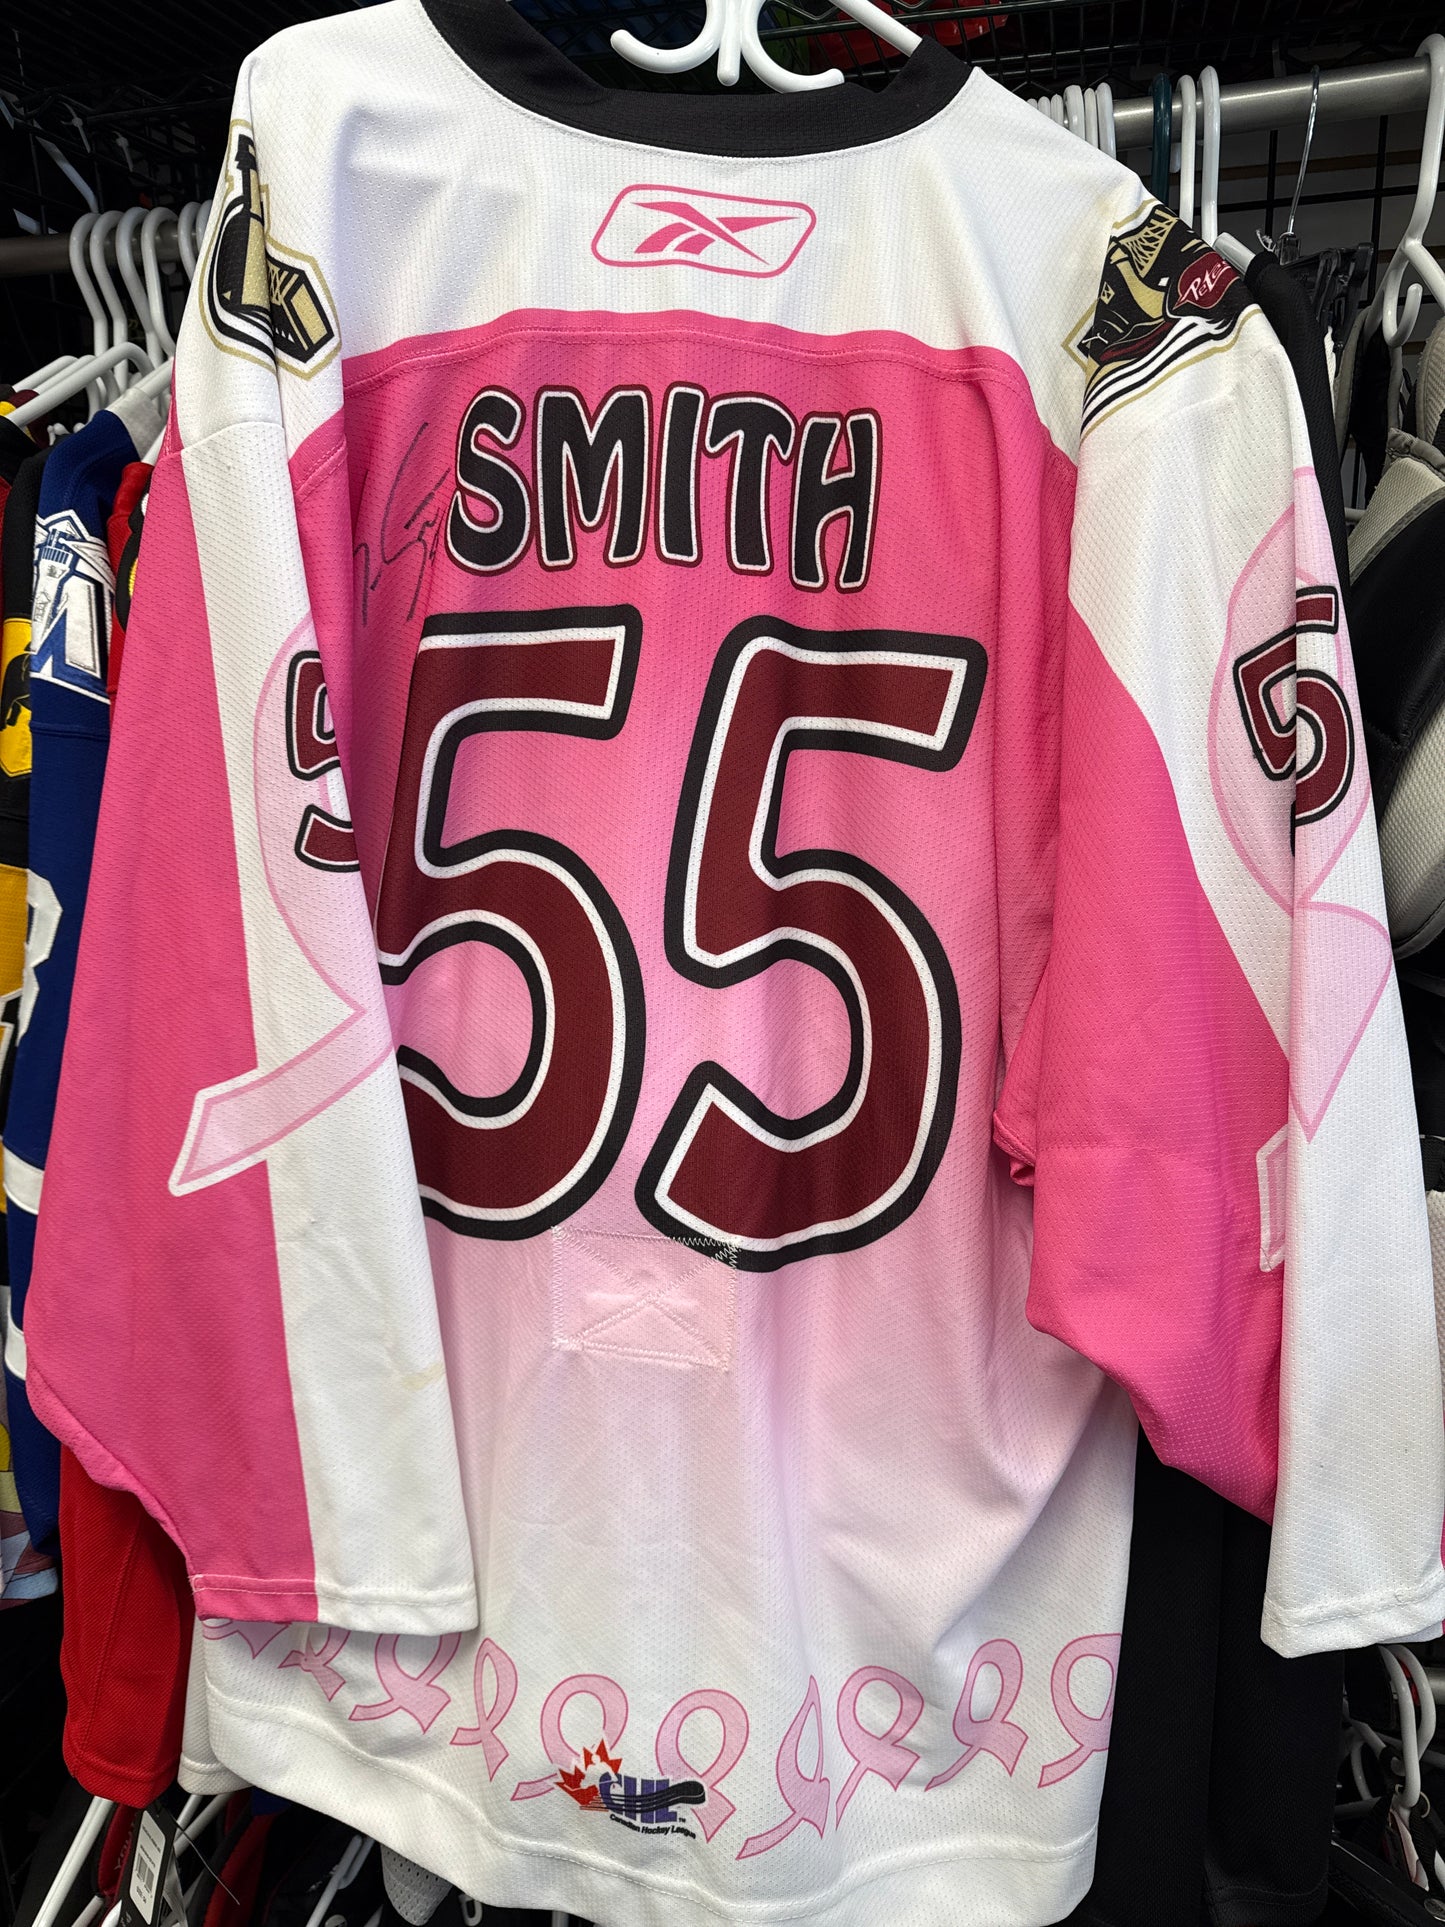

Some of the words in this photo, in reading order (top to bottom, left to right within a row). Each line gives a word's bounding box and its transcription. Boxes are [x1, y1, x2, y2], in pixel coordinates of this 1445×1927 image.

[446, 383, 883, 594] SMITH
[377, 604, 988, 1273] 55
[599, 1772, 677, 1824] CHL
[609, 1813, 640, 1833] Canadian
[641, 1825, 670, 1835] Hockey
[671, 1825, 696, 1839] League
